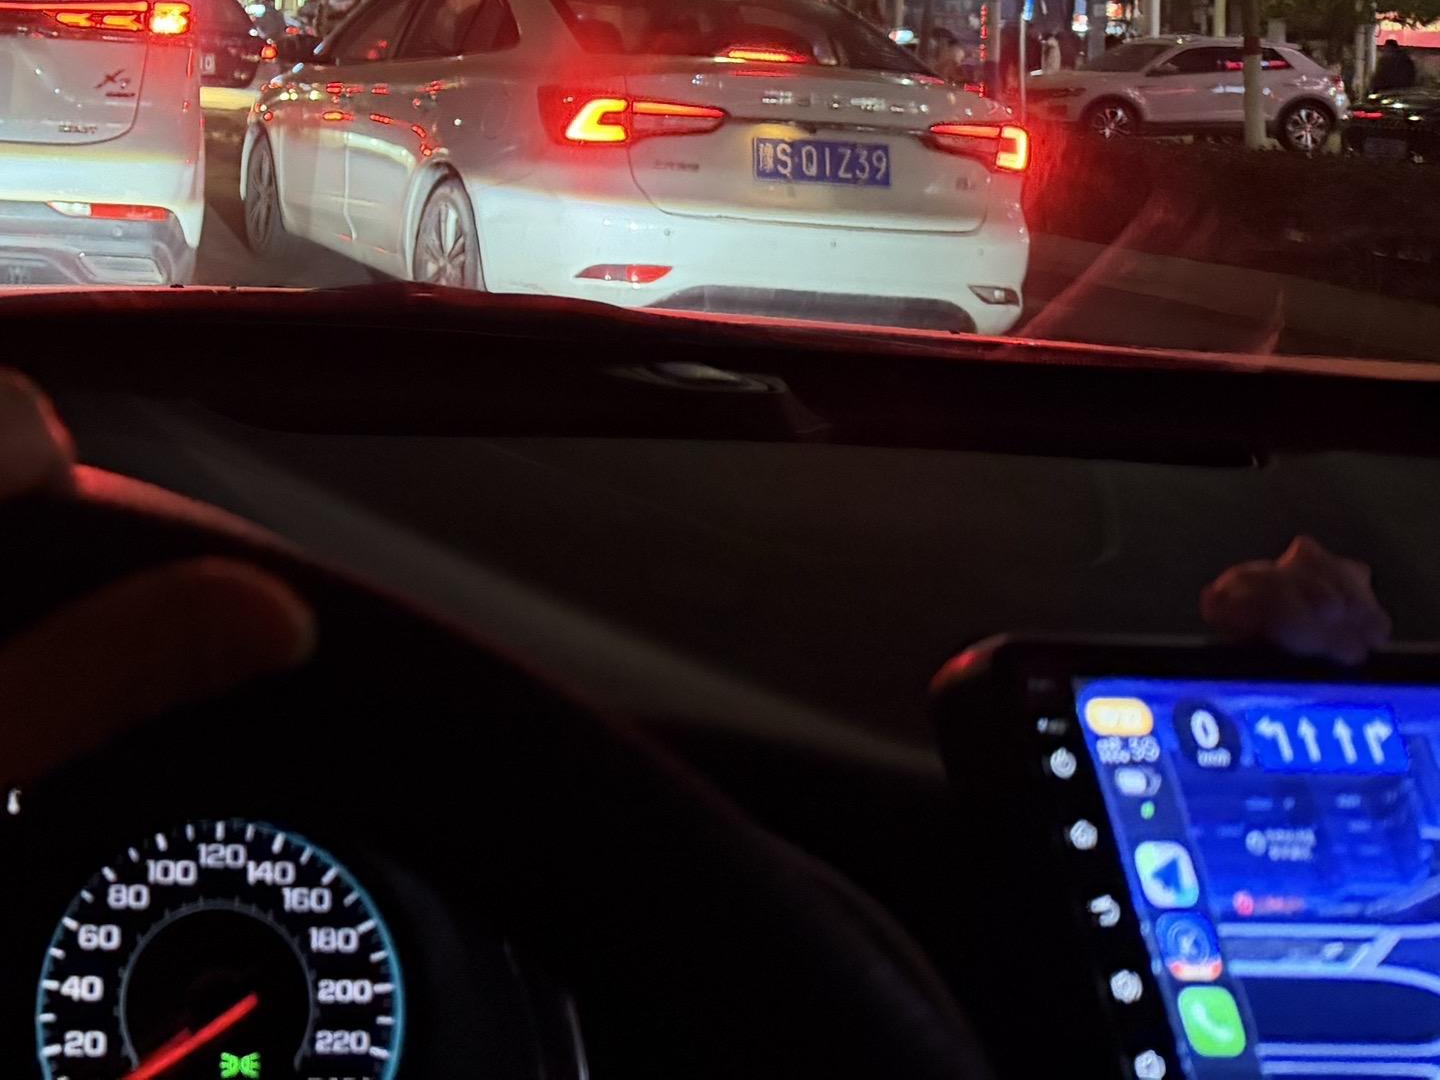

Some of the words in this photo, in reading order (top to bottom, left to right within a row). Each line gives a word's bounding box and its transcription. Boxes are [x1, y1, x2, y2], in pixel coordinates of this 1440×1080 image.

[198, 843, 246, 868] 120
[146, 860, 197, 885] 100
[246, 861, 295, 886] 140
[108, 884, 150, 909] 80
[282, 887, 331, 912] 160
[78, 925, 121, 950] 60
[310, 927, 357, 953] 180
[62, 976, 103, 1001] 40
[317, 979, 371, 1003] 200
[64, 1031, 107, 1057] 20
[315, 1030, 371, 1055] 220
